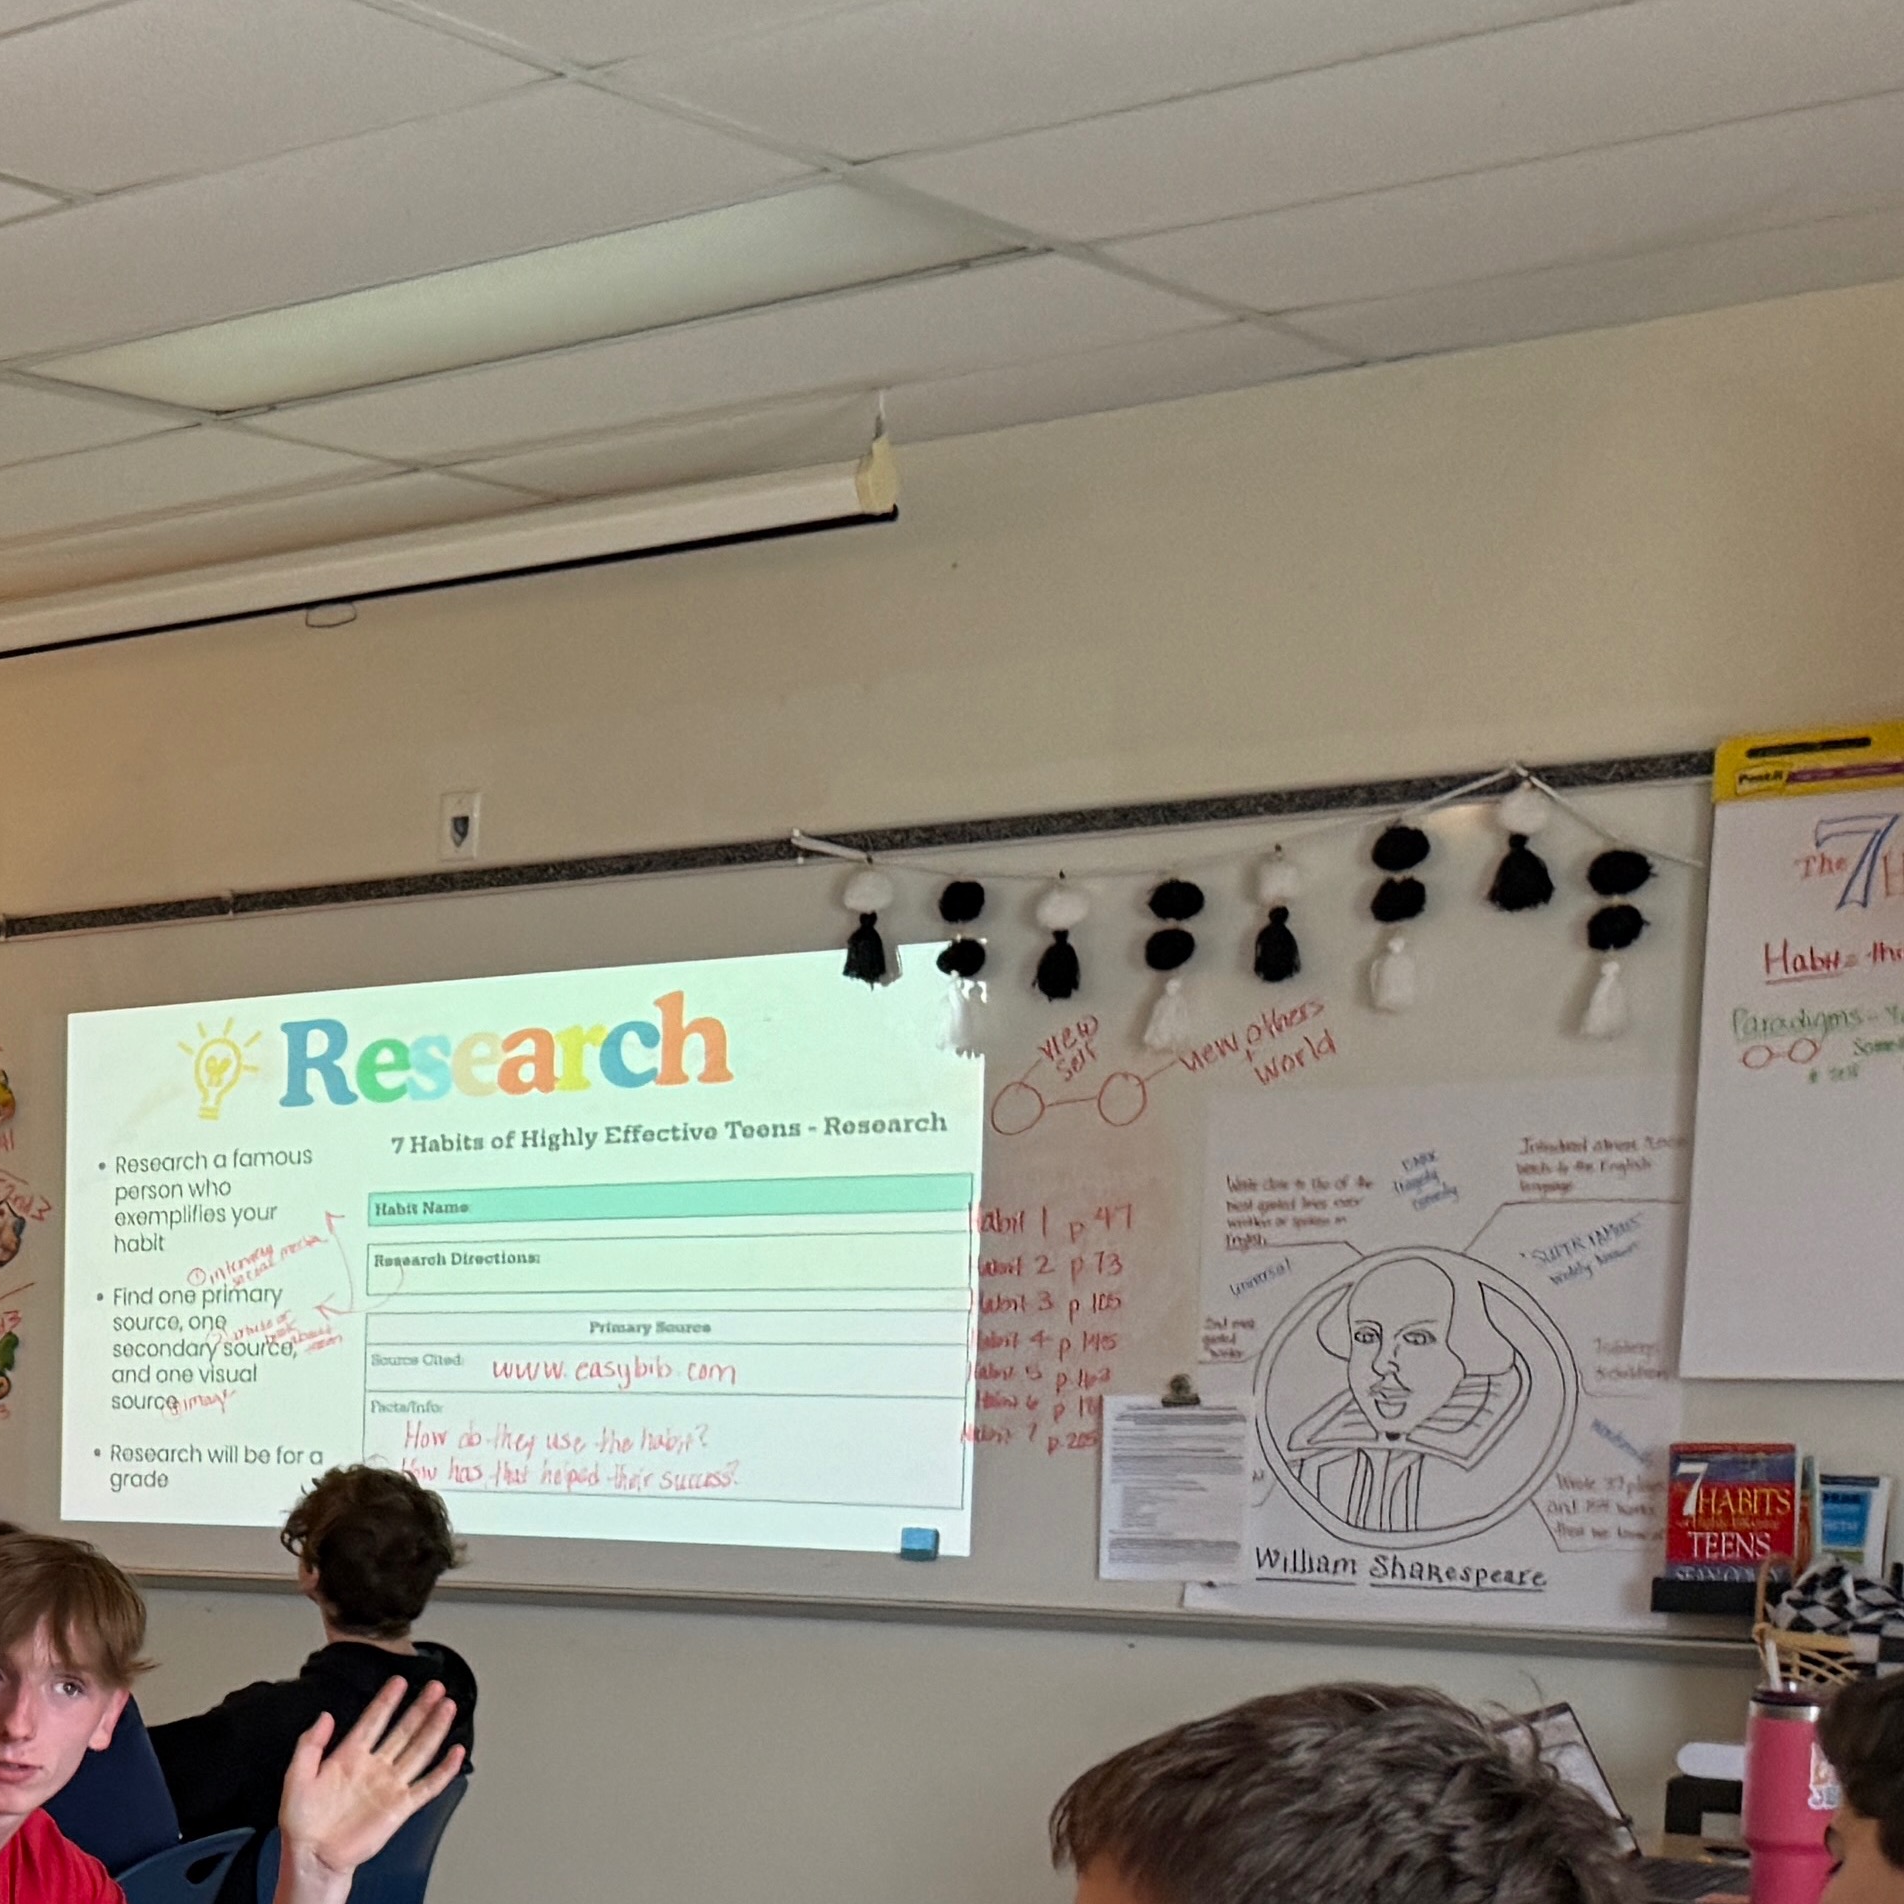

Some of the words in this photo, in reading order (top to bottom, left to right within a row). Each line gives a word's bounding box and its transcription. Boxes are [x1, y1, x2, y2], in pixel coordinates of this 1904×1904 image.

[280, 990, 734, 1107] Research
[391, 1136, 405, 1154] 7
[410, 1133, 485, 1154] Habits
[490, 1130, 517, 1149] of
[521, 1126, 599, 1151] Highly
[603, 1122, 718, 1145] Effective
[724, 1120, 802, 1140] Teens
[823, 1111, 948, 1136] Research
[115, 1150, 208, 1175] Research
[213, 1152, 228, 1169] a
[232, 1147, 314, 1168] famous
[114, 1181, 184, 1206] person
[188, 1178, 232, 1198] who
[114, 1203, 227, 1231] exemplifies
[231, 1205, 279, 1228] your
[374, 1202, 419, 1217] Habit
[113, 1233, 166, 1254] habit
[374, 1252, 447, 1268] Research
[1035, 1255, 1055, 1274] 2
[1095, 1251, 1123, 1276] 73
[112, 1286, 154, 1307] Find
[158, 1289, 196, 1306] one
[201, 1283, 284, 1309] primary
[1038, 1290, 1055, 1312] 3
[112, 1313, 184, 1333] source,
[188, 1312, 228, 1331] one
[589, 1320, 652, 1336] Primary
[655, 1320, 712, 1334] Source
[112, 1338, 218, 1362] secondary
[222, 1339, 298, 1360] source,
[370, 1353, 419, 1367] Source
[111, 1364, 151, 1384] and
[156, 1366, 194, 1383] one
[198, 1363, 258, 1384] visual
[111, 1393, 180, 1412] source
[404, 1419, 448, 1450] How
[485, 1422, 537, 1457] they
[546, 1433, 587, 1453] use
[594, 1426, 635, 1454] the
[109, 1443, 202, 1464] Research
[207, 1444, 239, 1464] will
[243, 1444, 271, 1465] be
[275, 1444, 305, 1465] for
[308, 1448, 324, 1466] a
[109, 1469, 169, 1492] grade
[447, 1456, 484, 1483] has
[1675, 1461, 1709, 1517] 7
[1697, 1487, 1791, 1516] HABITS
[1687, 1531, 1772, 1561] TEENS
[1255, 1545, 1358, 1578] William
